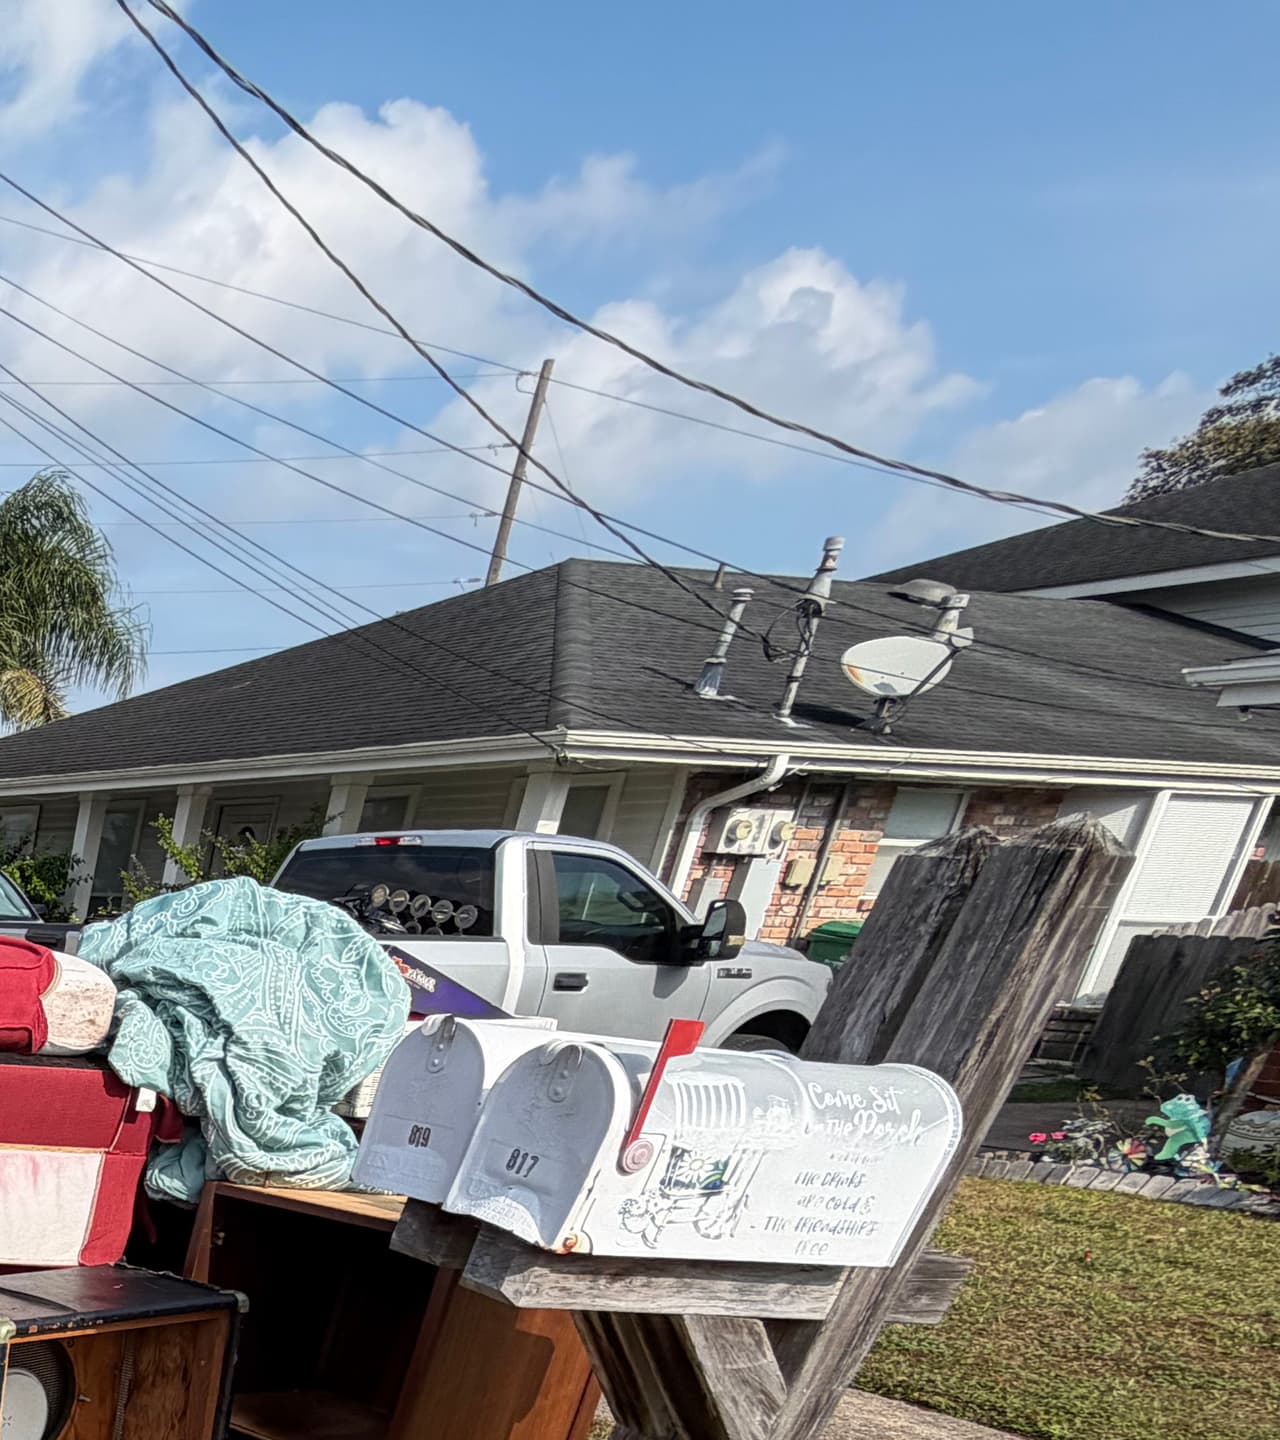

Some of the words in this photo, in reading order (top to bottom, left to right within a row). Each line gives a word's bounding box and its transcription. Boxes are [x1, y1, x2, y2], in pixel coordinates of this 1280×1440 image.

[808, 1082, 867, 1110] Come
[868, 1086, 905, 1114] Sit
[408, 1124, 431, 1147] 819
[505, 1148, 540, 1178] 817
